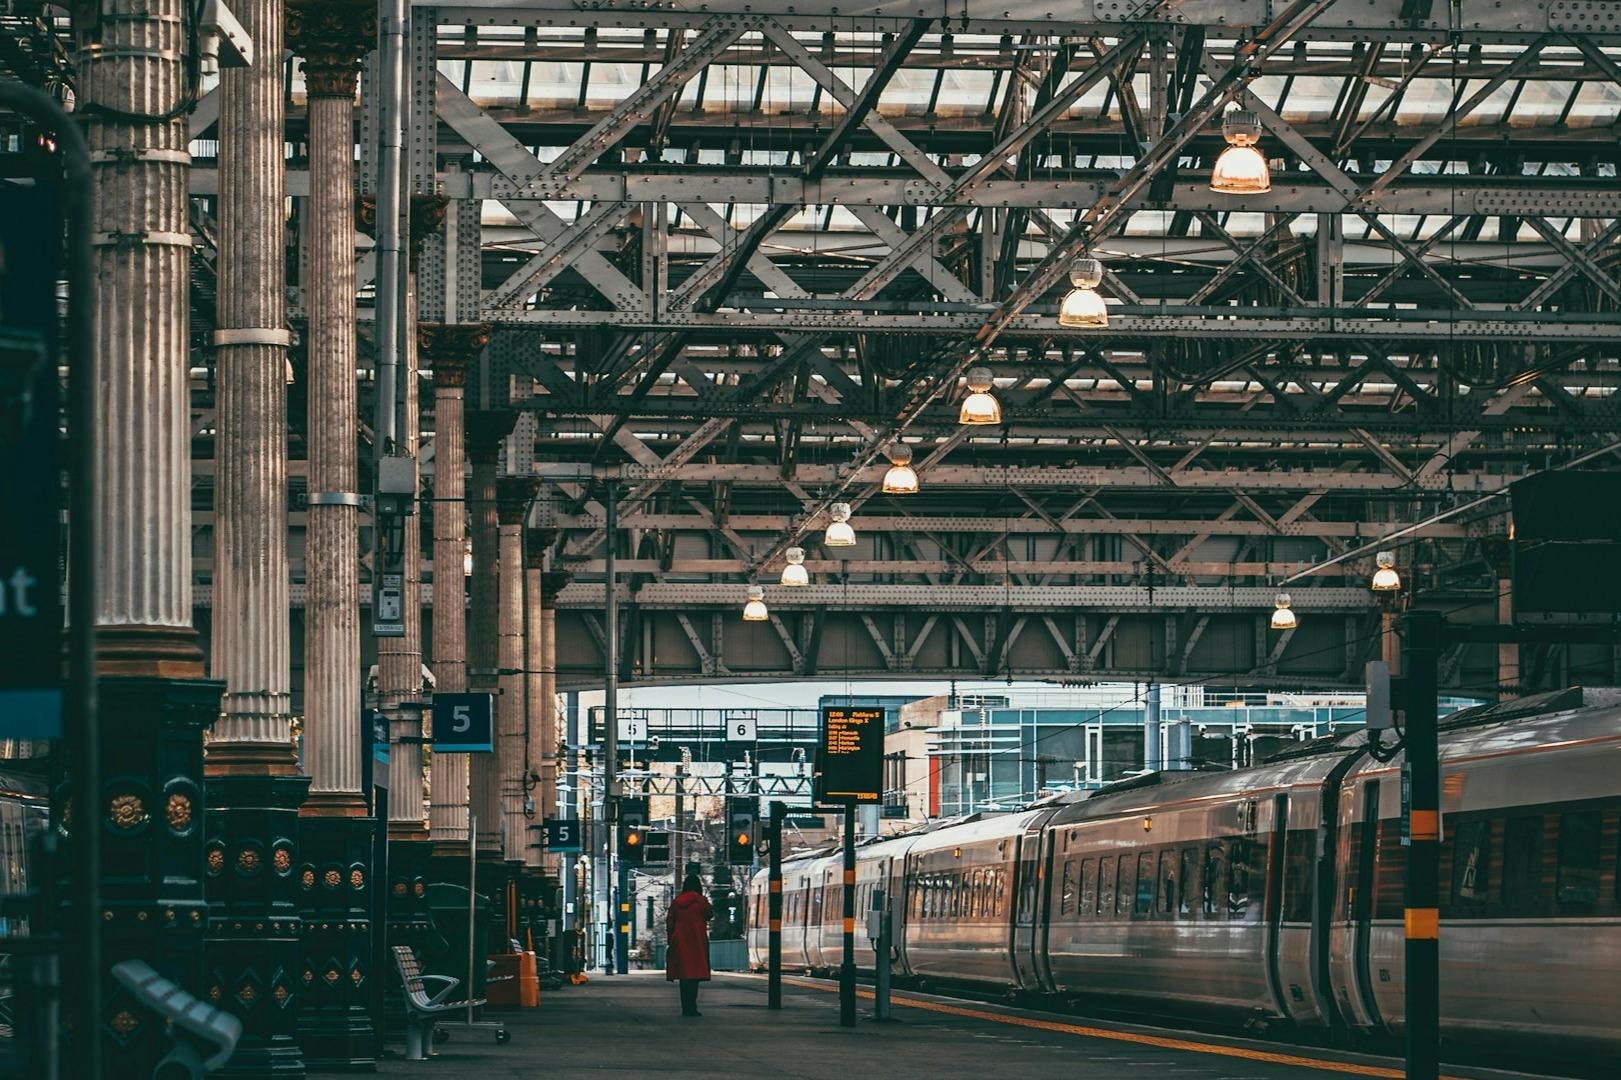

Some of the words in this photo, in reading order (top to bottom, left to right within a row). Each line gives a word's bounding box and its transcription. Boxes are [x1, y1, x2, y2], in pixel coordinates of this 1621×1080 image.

[452, 705, 471, 733] 5
[737, 724, 746, 736] 6
[559, 826, 570, 842] 5
